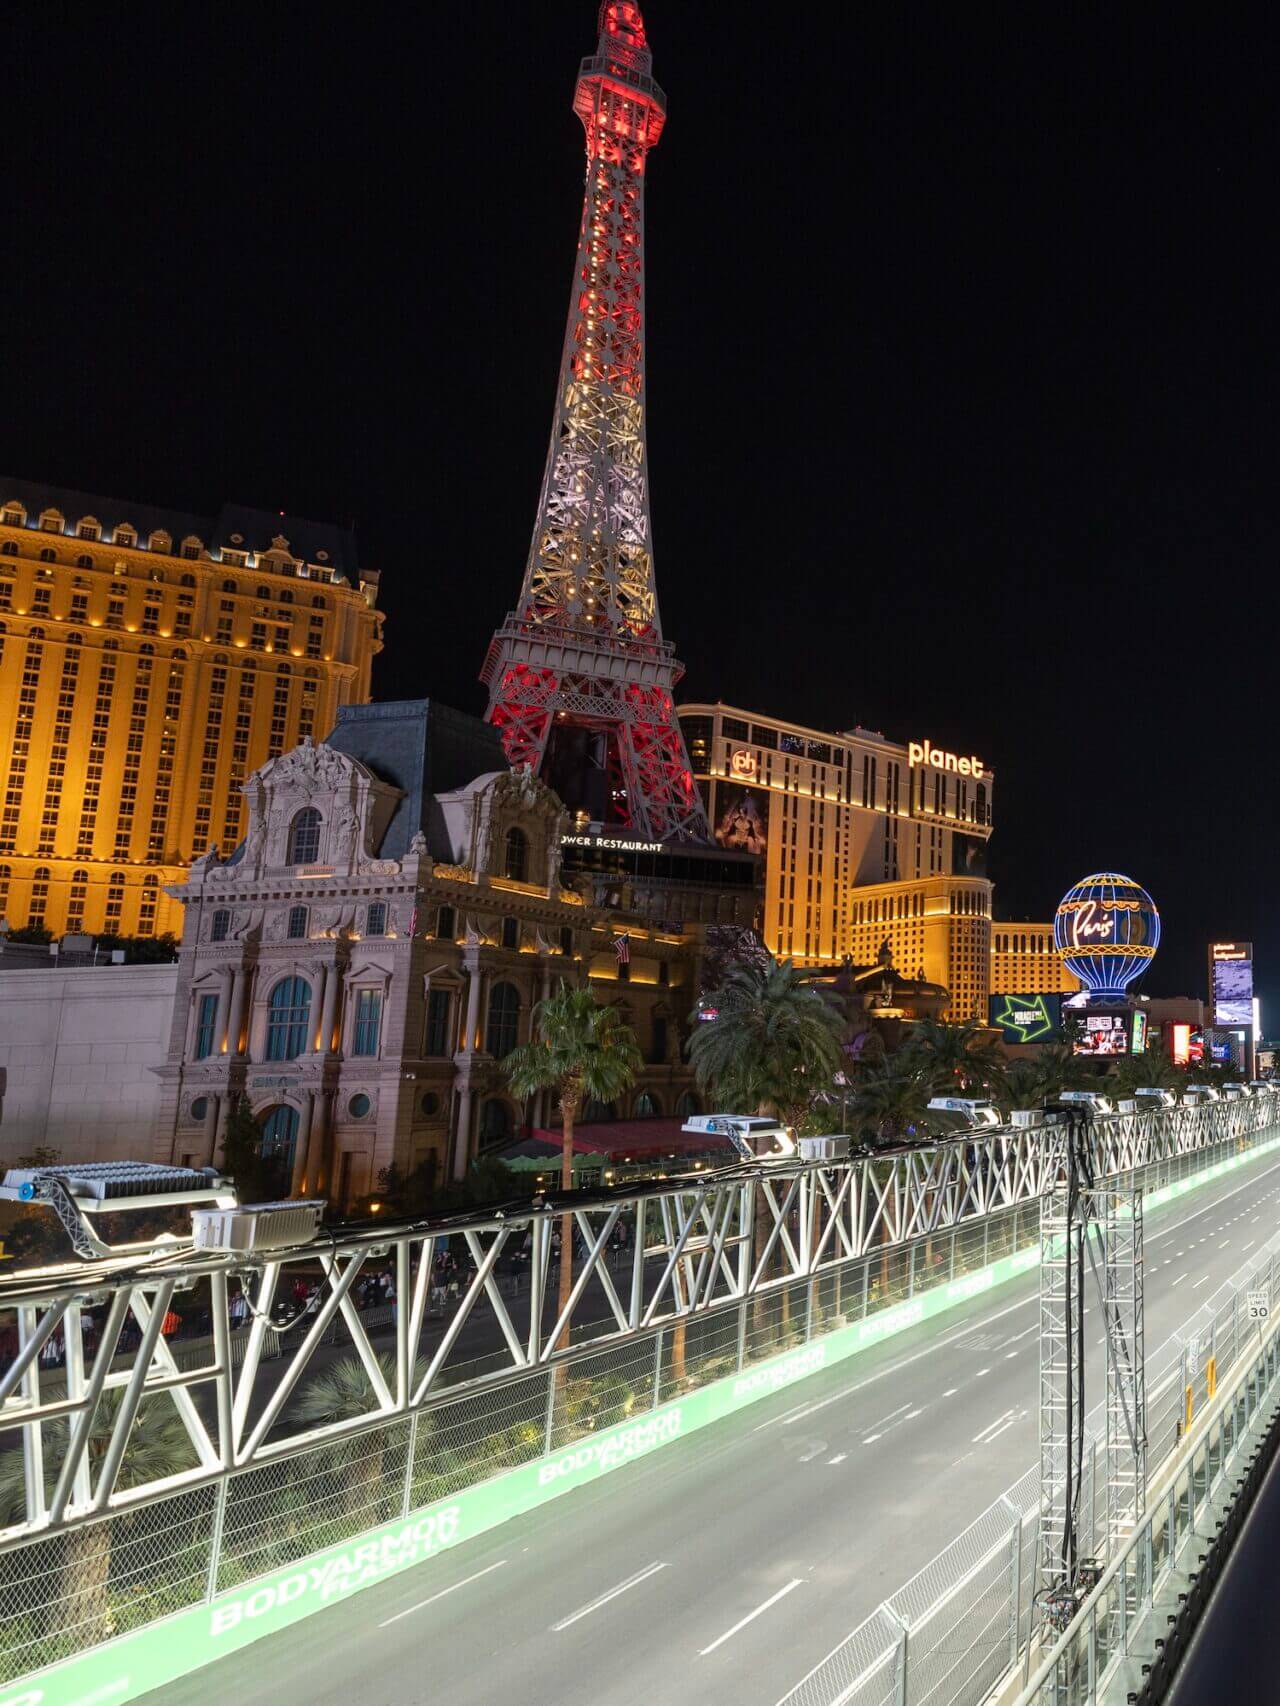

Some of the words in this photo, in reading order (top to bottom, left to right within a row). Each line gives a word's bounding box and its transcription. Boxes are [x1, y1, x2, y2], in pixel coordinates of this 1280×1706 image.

[734, 751, 757, 773] ph
[908, 740, 984, 779] planet
[596, 838, 663, 852] RESTAURANT
[1072, 900, 1114, 950] Paris
[1250, 1307, 1268, 1317] 30
[538, 1407, 682, 1486] BODYARMOR
[208, 1505, 461, 1637] BODYARMOR
